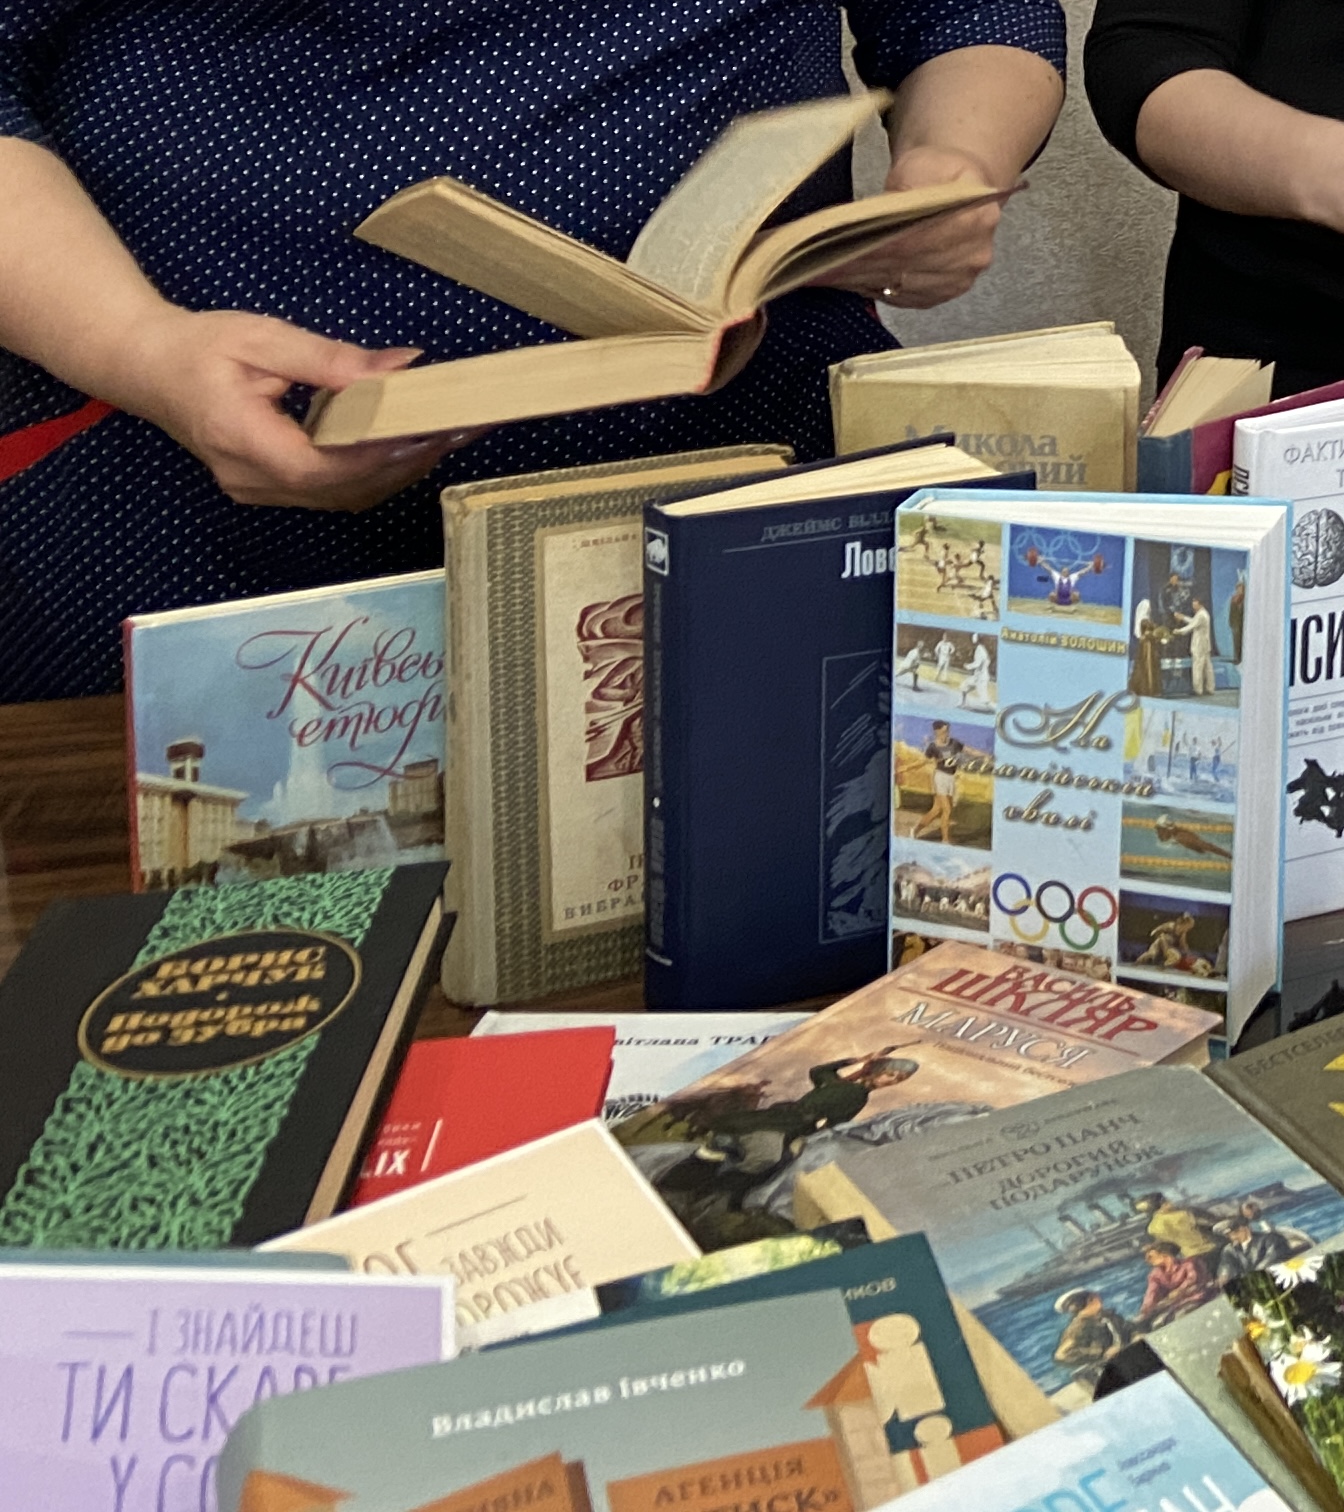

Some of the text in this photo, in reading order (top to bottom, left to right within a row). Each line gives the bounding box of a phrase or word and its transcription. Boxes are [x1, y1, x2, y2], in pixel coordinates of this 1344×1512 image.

[1000, 625, 1057, 645] Анатолій
[996, 686, 1141, 754] На
[889, 999, 1100, 1071] МАРУСЯ
[928, 967, 1160, 1042] ШКЛЯР
[945, 1140, 1053, 1186] ПЕТРО
[1052, 1112, 1143, 1150] ПАНЧ
[988, 1144, 1167, 1212] ПОДАРУНОК
[999, 1138, 1129, 1195] ДОРОГИЙ
[177, 1301, 360, 1359] ЗНАЙДЕШ
[58, 1359, 136, 1444] ТИ
[430, 1359, 747, 1441] Владислав Івченко
[653, 1454, 807, 1509] АГЕНЦІЯ
